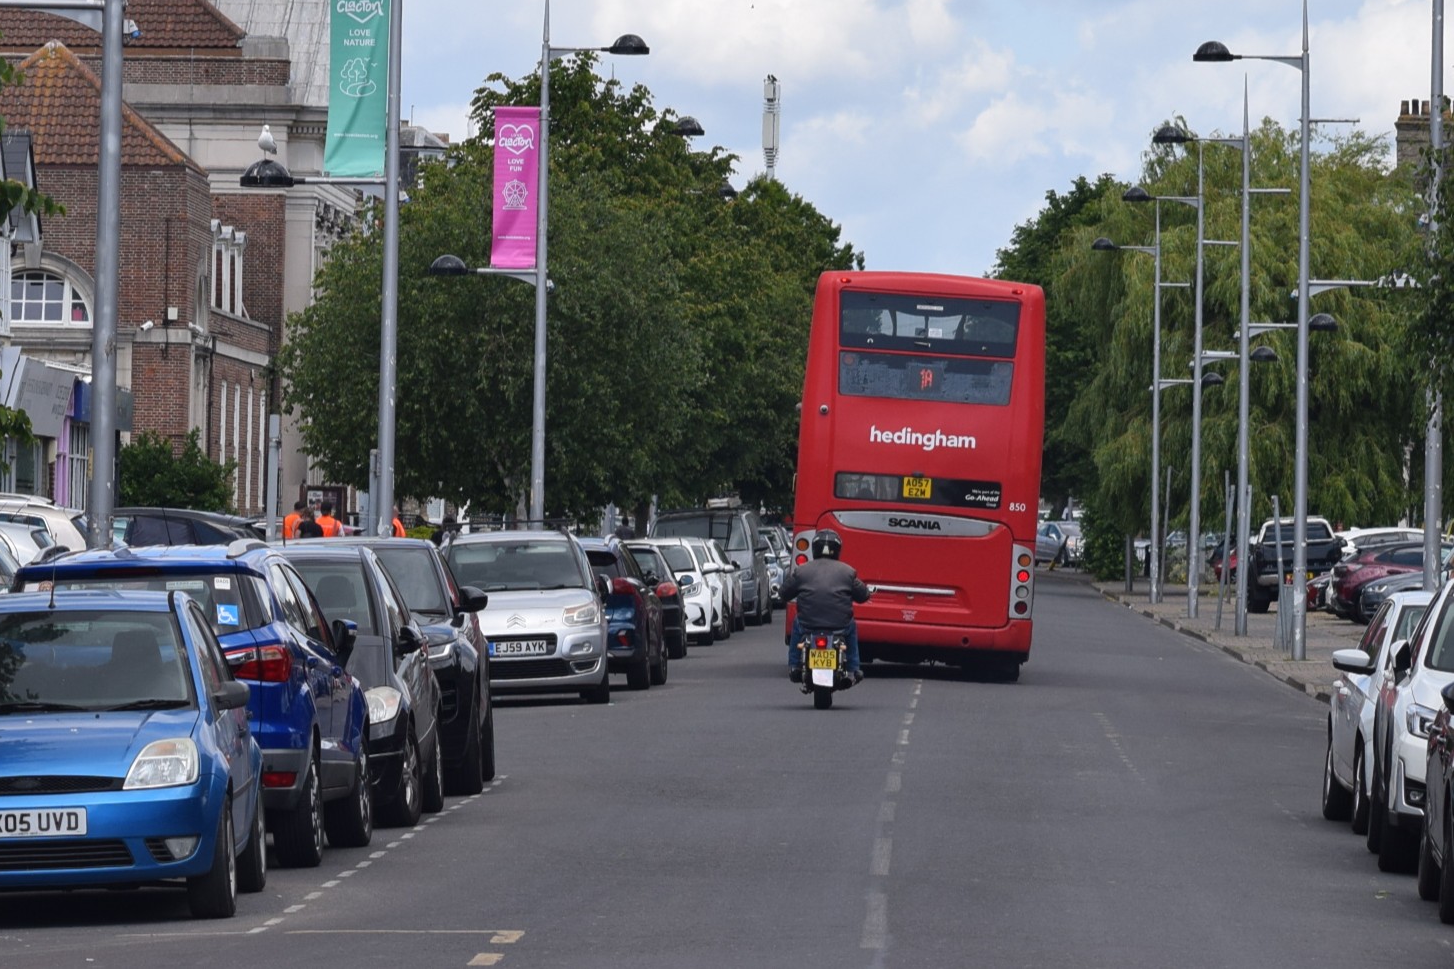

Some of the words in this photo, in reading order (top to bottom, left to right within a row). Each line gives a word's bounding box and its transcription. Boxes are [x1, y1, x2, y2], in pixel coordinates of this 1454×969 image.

[349, 29, 371, 37] LOVE
[343, 38, 376, 47] NATURE
[869, 425, 977, 451] hedingham
[908, 487, 927, 498] EZM
[1008, 502, 1027, 512] 850
[888, 517, 942, 531] SCANIA
[495, 642, 522, 653] EJ59
[525, 641, 545, 652] AYK
[37, 811, 80, 832] UVD
